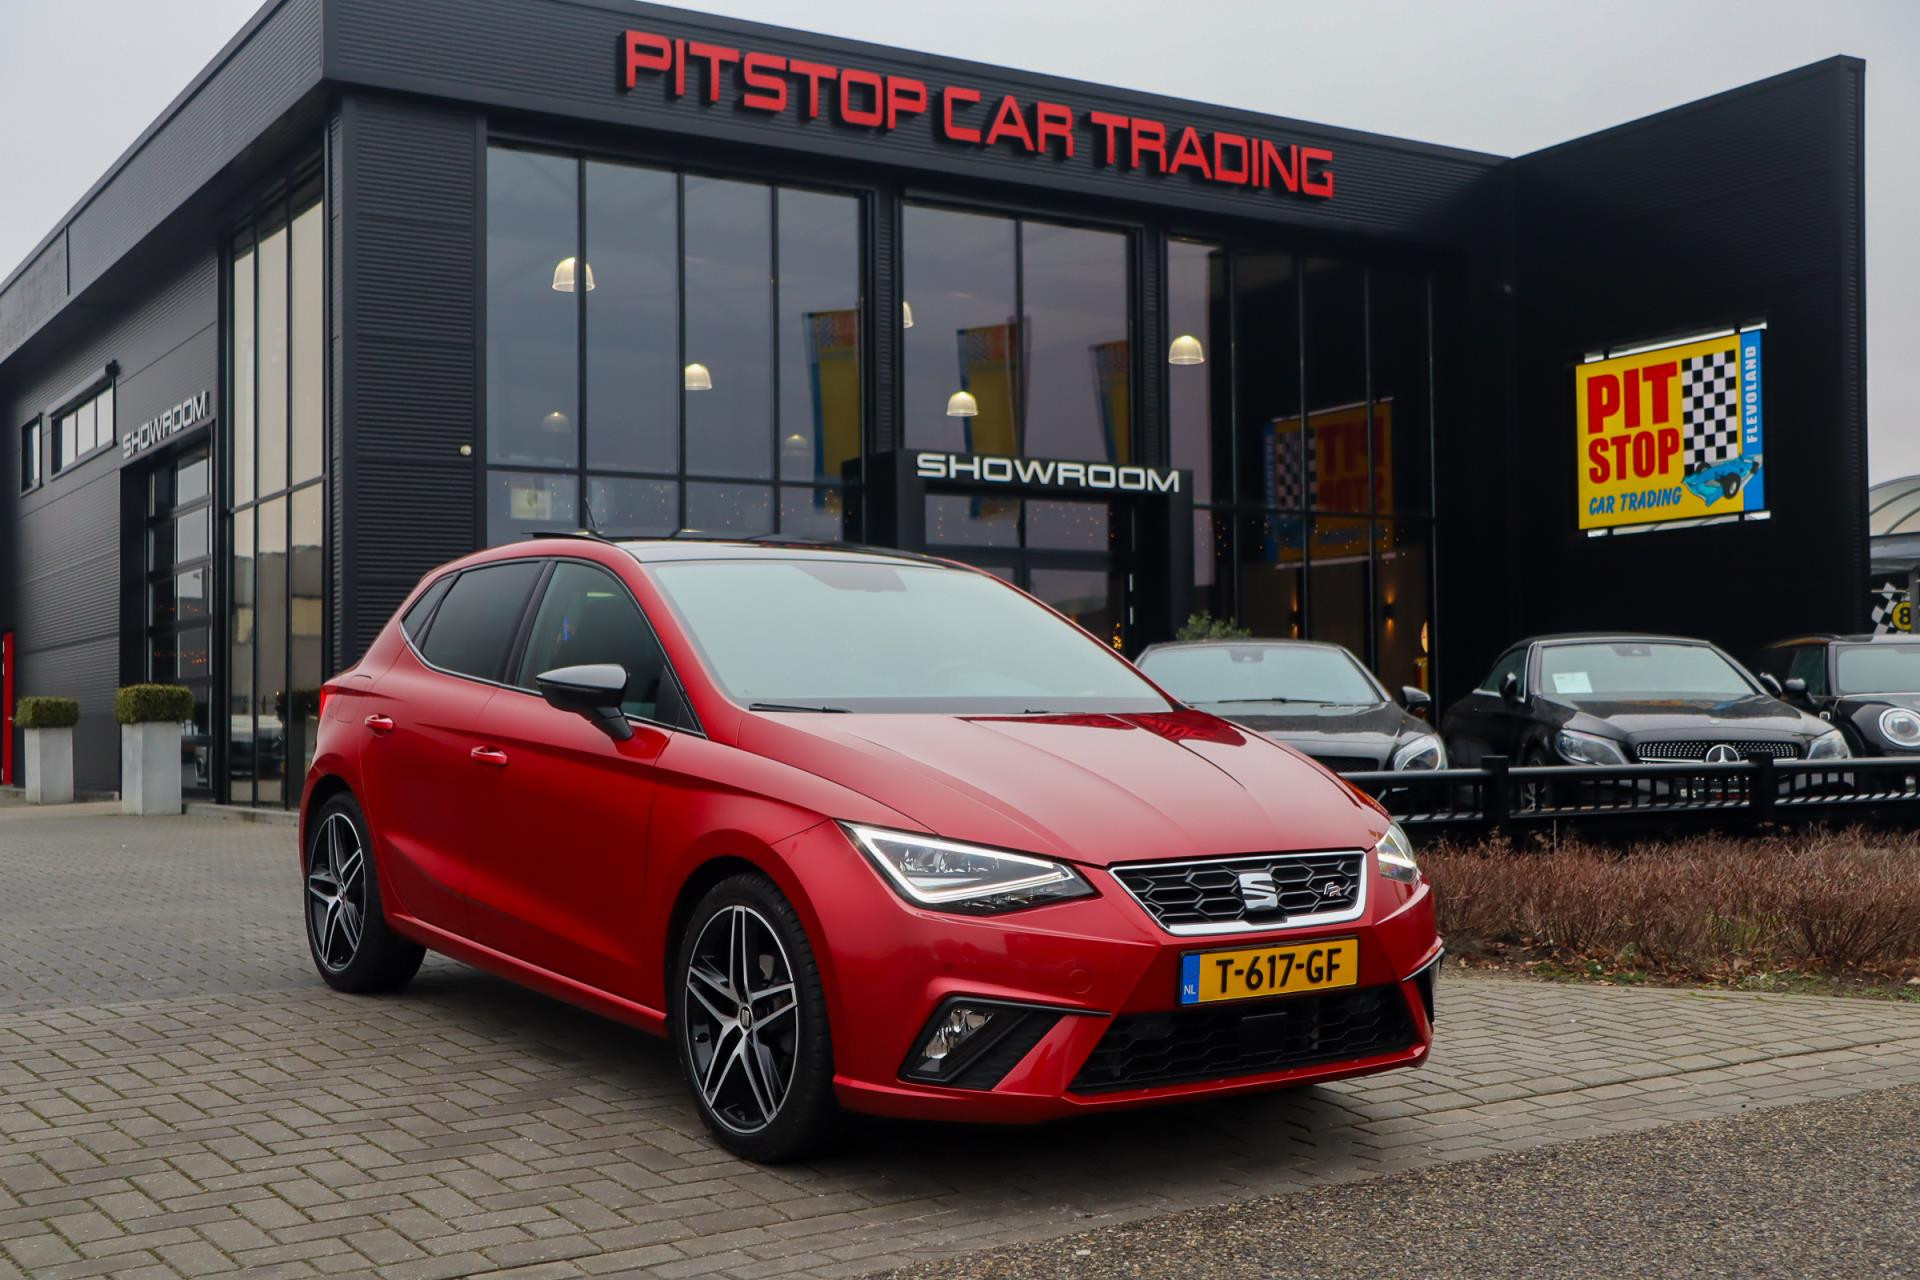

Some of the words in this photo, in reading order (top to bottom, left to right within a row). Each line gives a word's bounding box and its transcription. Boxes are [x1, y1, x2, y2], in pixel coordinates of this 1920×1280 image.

[626, 29, 927, 129] PITSTOP
[943, 85, 1074, 158] CAR
[1091, 111, 1334, 198] TRADING
[1586, 361, 1678, 435] PIT
[1744, 345, 1758, 444] FLEVOLAND
[122, 390, 206, 460] SHOWROOM
[917, 452, 1180, 493] SHOWROOM
[1588, 428, 1680, 484] STOP
[1589, 497, 1616, 515] CAR
[1619, 487, 1682, 512] TRADING
[1183, 984, 1197, 995] NL
[1216, 948, 1342, 993] T-617-GF
